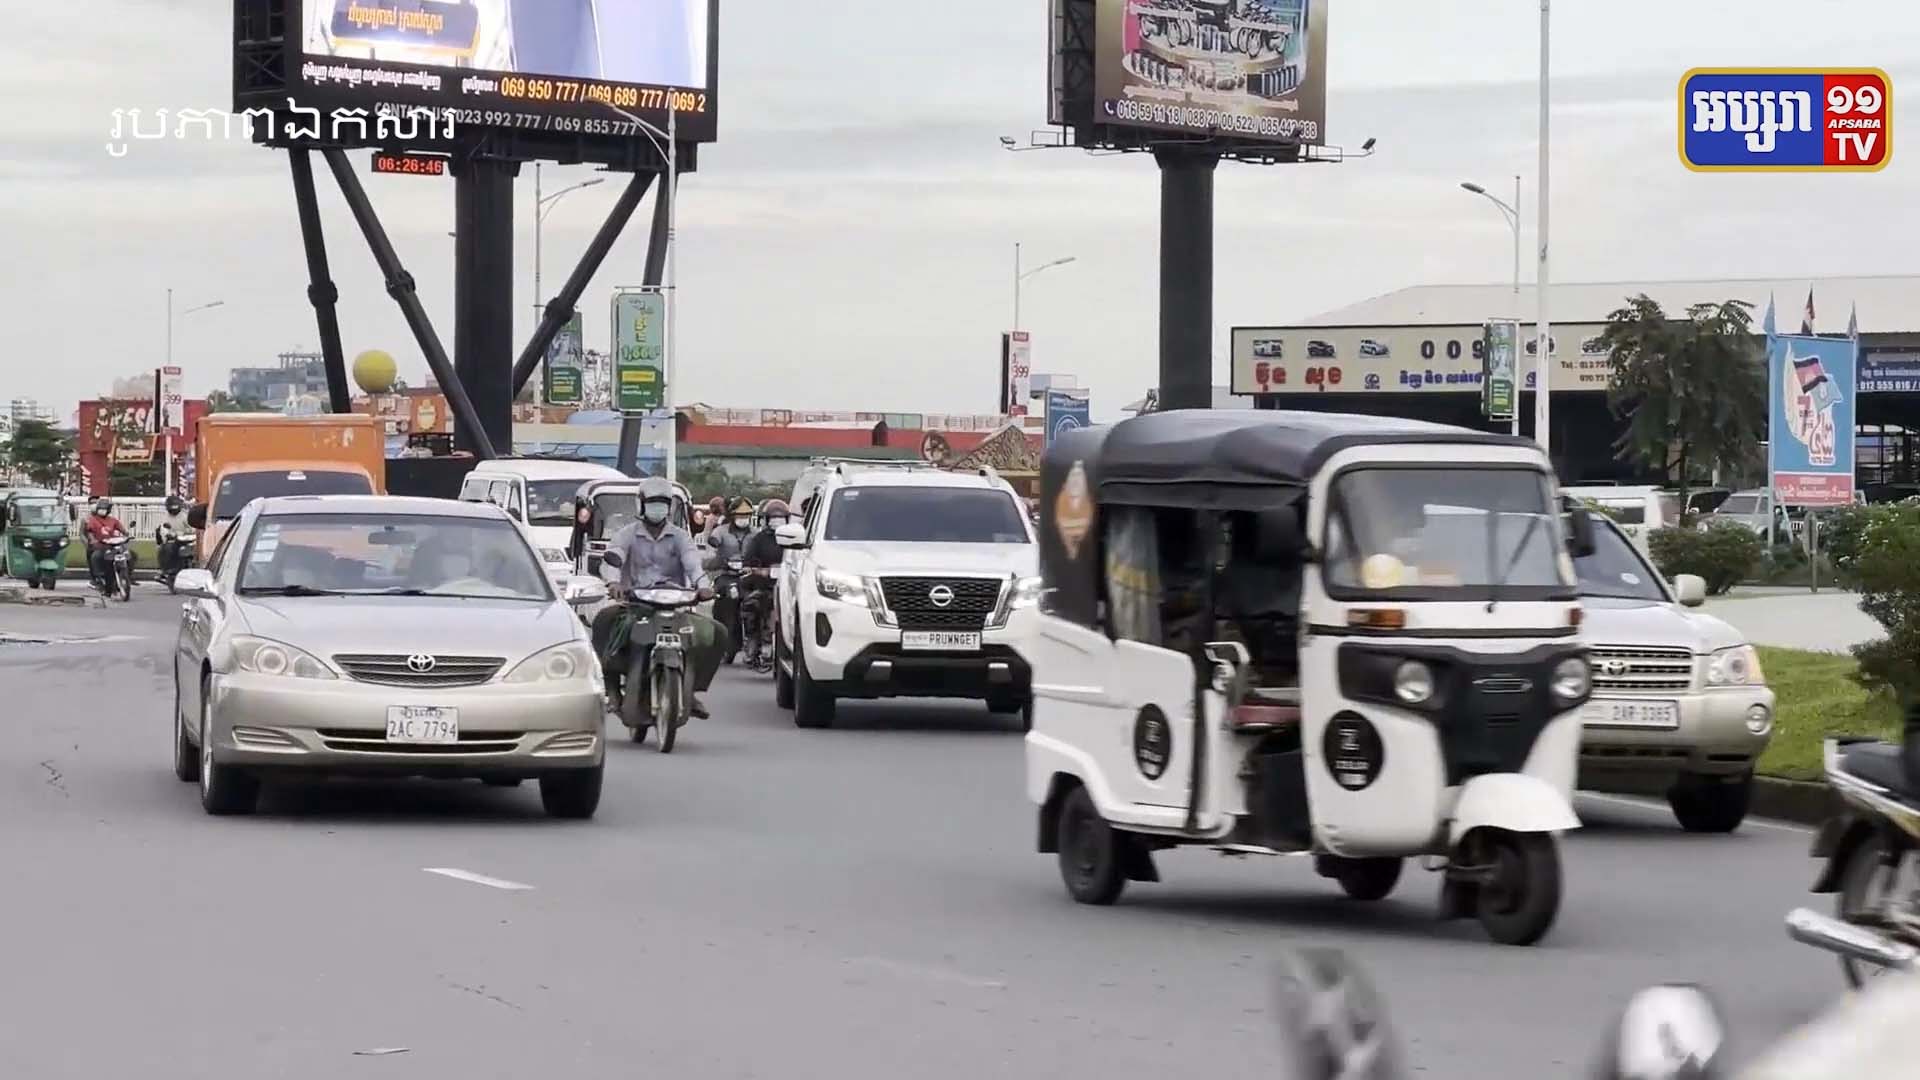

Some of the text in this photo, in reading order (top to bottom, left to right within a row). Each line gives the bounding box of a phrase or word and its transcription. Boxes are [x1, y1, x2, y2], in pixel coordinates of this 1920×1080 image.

[501, 77, 524, 97] 069
[528, 80, 552, 100] 950
[555, 82, 578, 102] 777
[614, 87, 637, 106] 689
[641, 90, 664, 109] 777
[672, 92, 695, 111] 069
[456, 109, 481, 123] 023
[485, 111, 511, 126] 992
[515, 113, 541, 129] 777
[555, 117, 580, 131] 069
[584, 119, 609, 133] 855
[612, 121, 637, 135] 777
[1117, 100, 1137, 118] 016
[1139, 103, 1153, 120] 59
[1153, 104, 1166, 122] 11
[1166, 105, 1180, 124] 18
[1186, 108, 1206, 127] 088
[1235, 114, 1254, 132] 522
[1260, 116, 1278, 135] 085
[378, 157, 443, 173] 06:26:46
[1012, 365, 1029, 378] 399
